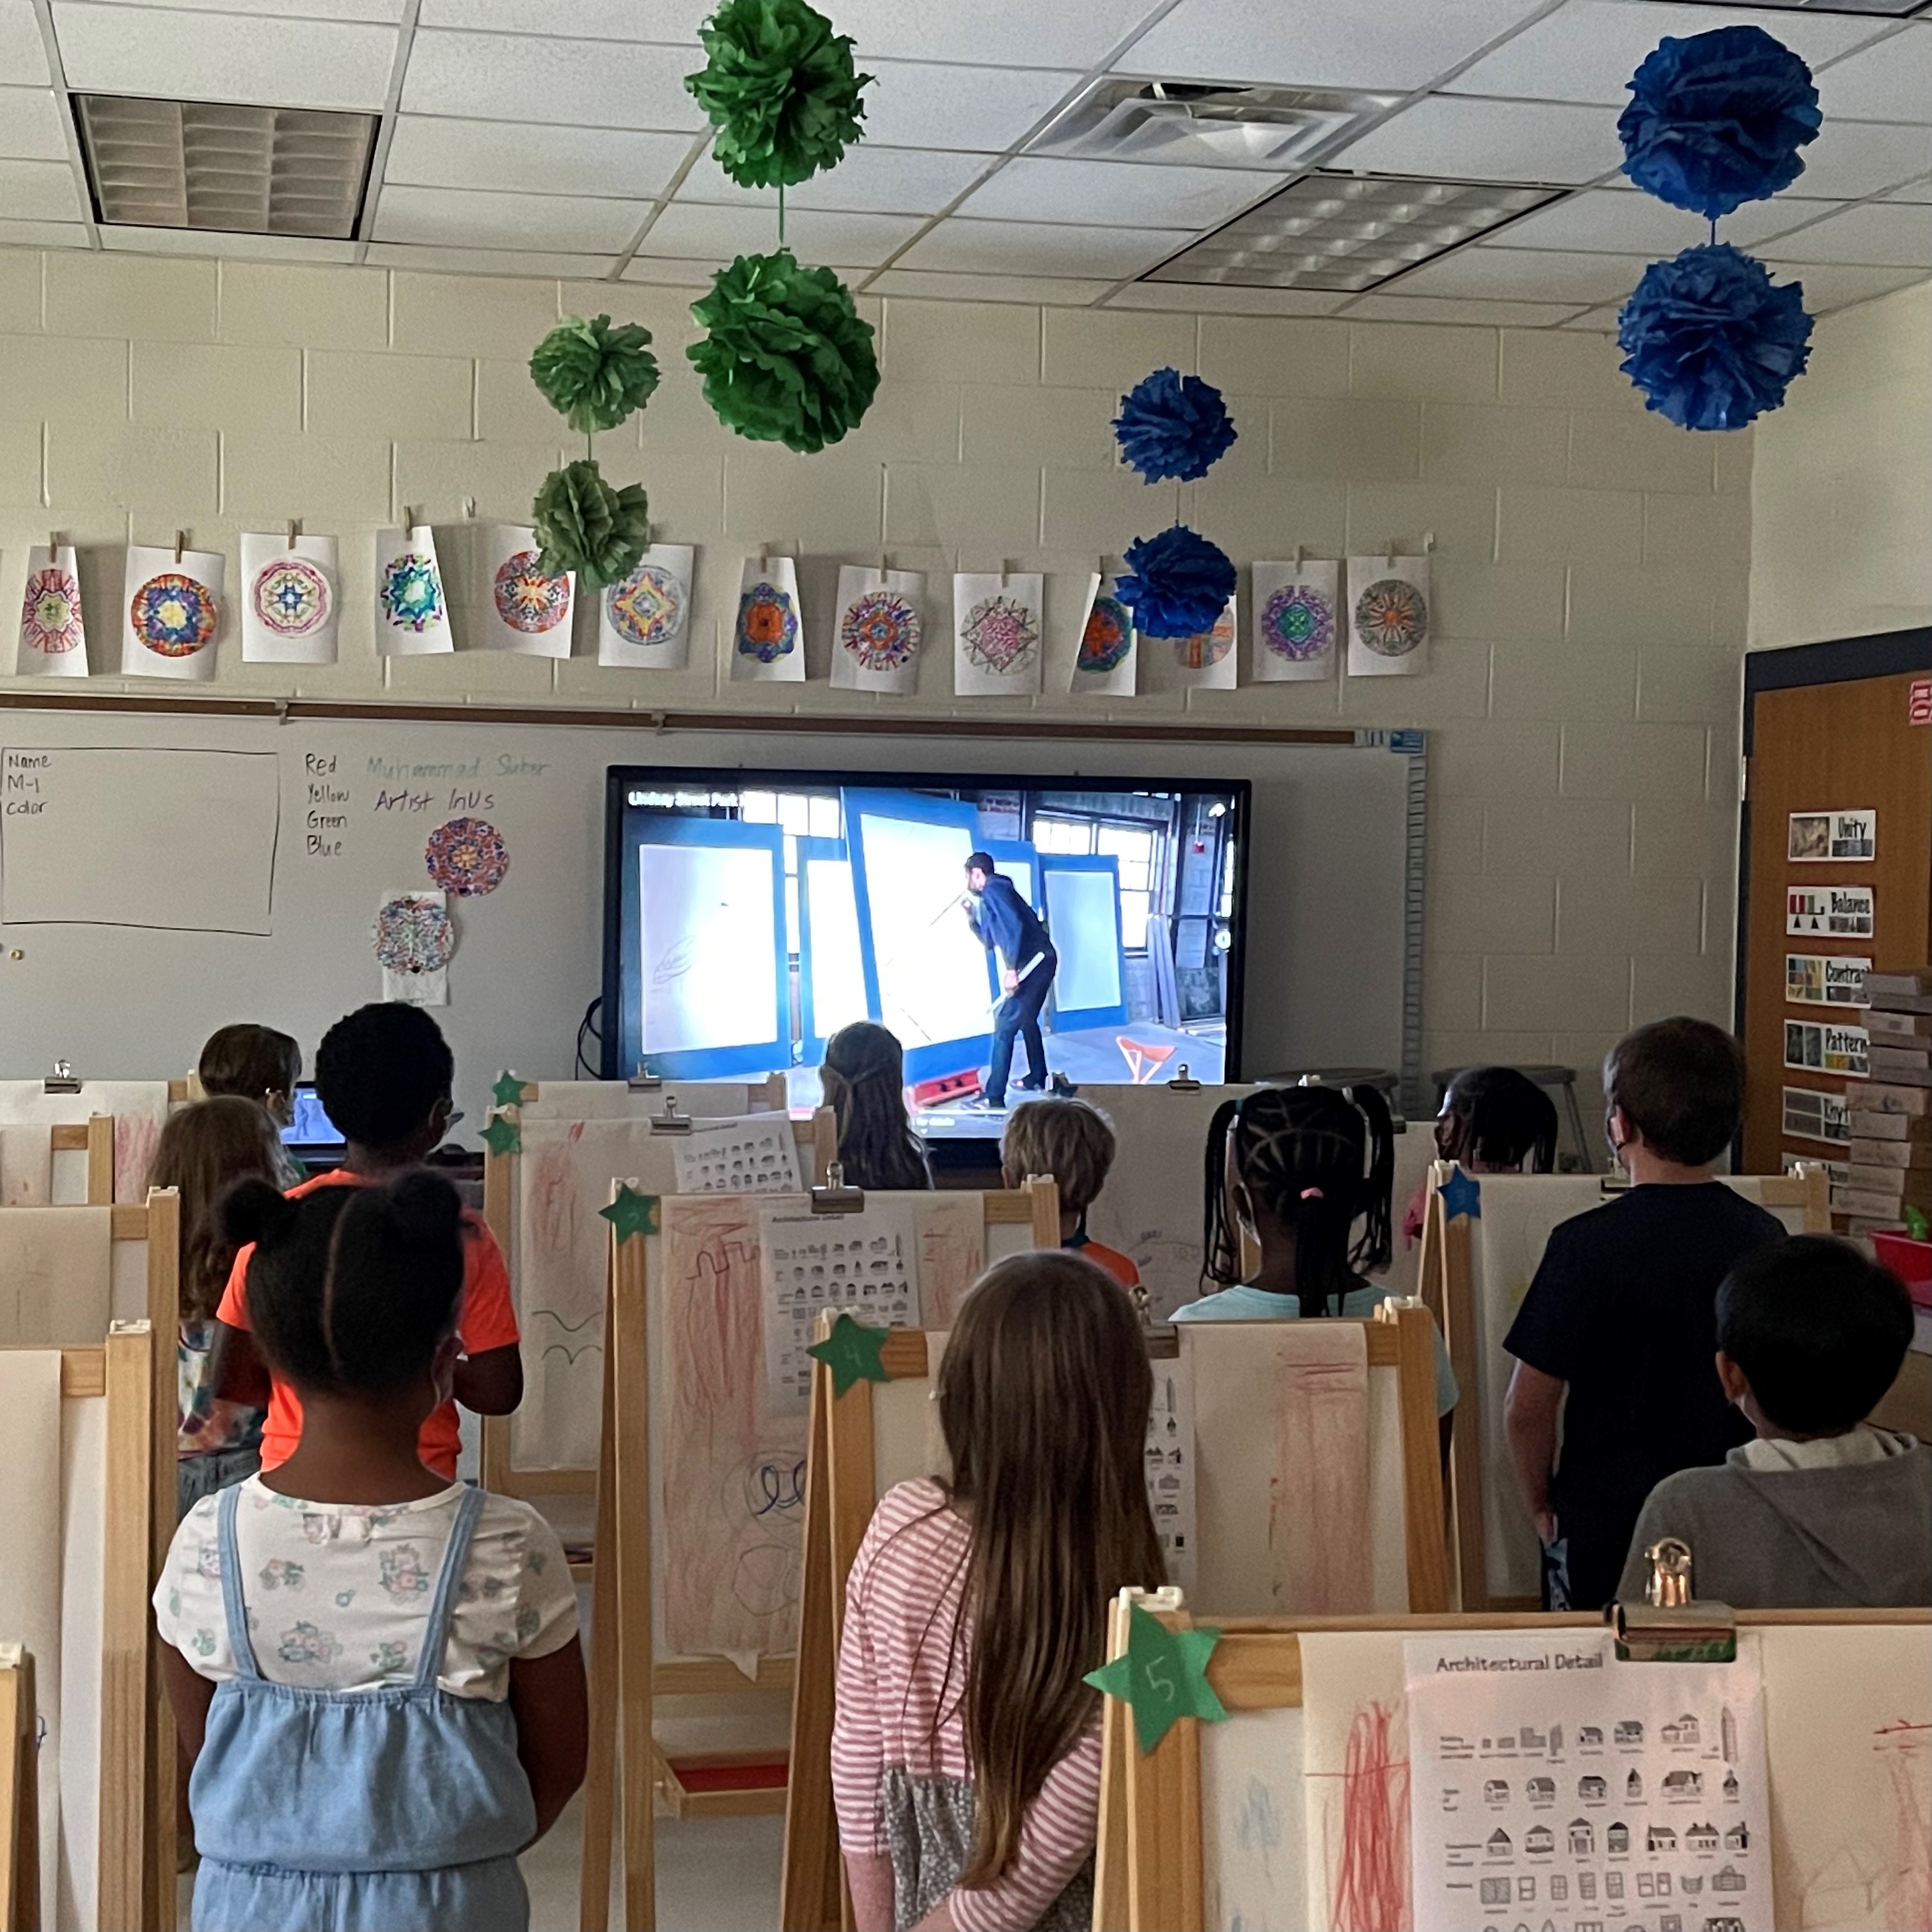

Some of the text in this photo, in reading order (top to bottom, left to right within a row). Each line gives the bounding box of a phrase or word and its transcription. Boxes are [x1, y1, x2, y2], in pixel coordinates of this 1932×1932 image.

[8, 754, 52, 769] Name
[305, 753, 337, 777] Red
[308, 783, 350, 805] Yellow
[373, 789, 434, 813] Artist
[6, 799, 49, 815] Color
[307, 810, 348, 829] Green
[1837, 816, 1867, 841] Unity
[306, 834, 343, 857] Blue
[1831, 890, 1871, 915] Balance
[1825, 960, 1871, 984] Contra
[1825, 1027, 1867, 1054] Pattern
[1436, 1653, 1603, 1672] Architectural Detail
[1145, 1655, 1175, 1702] 5
